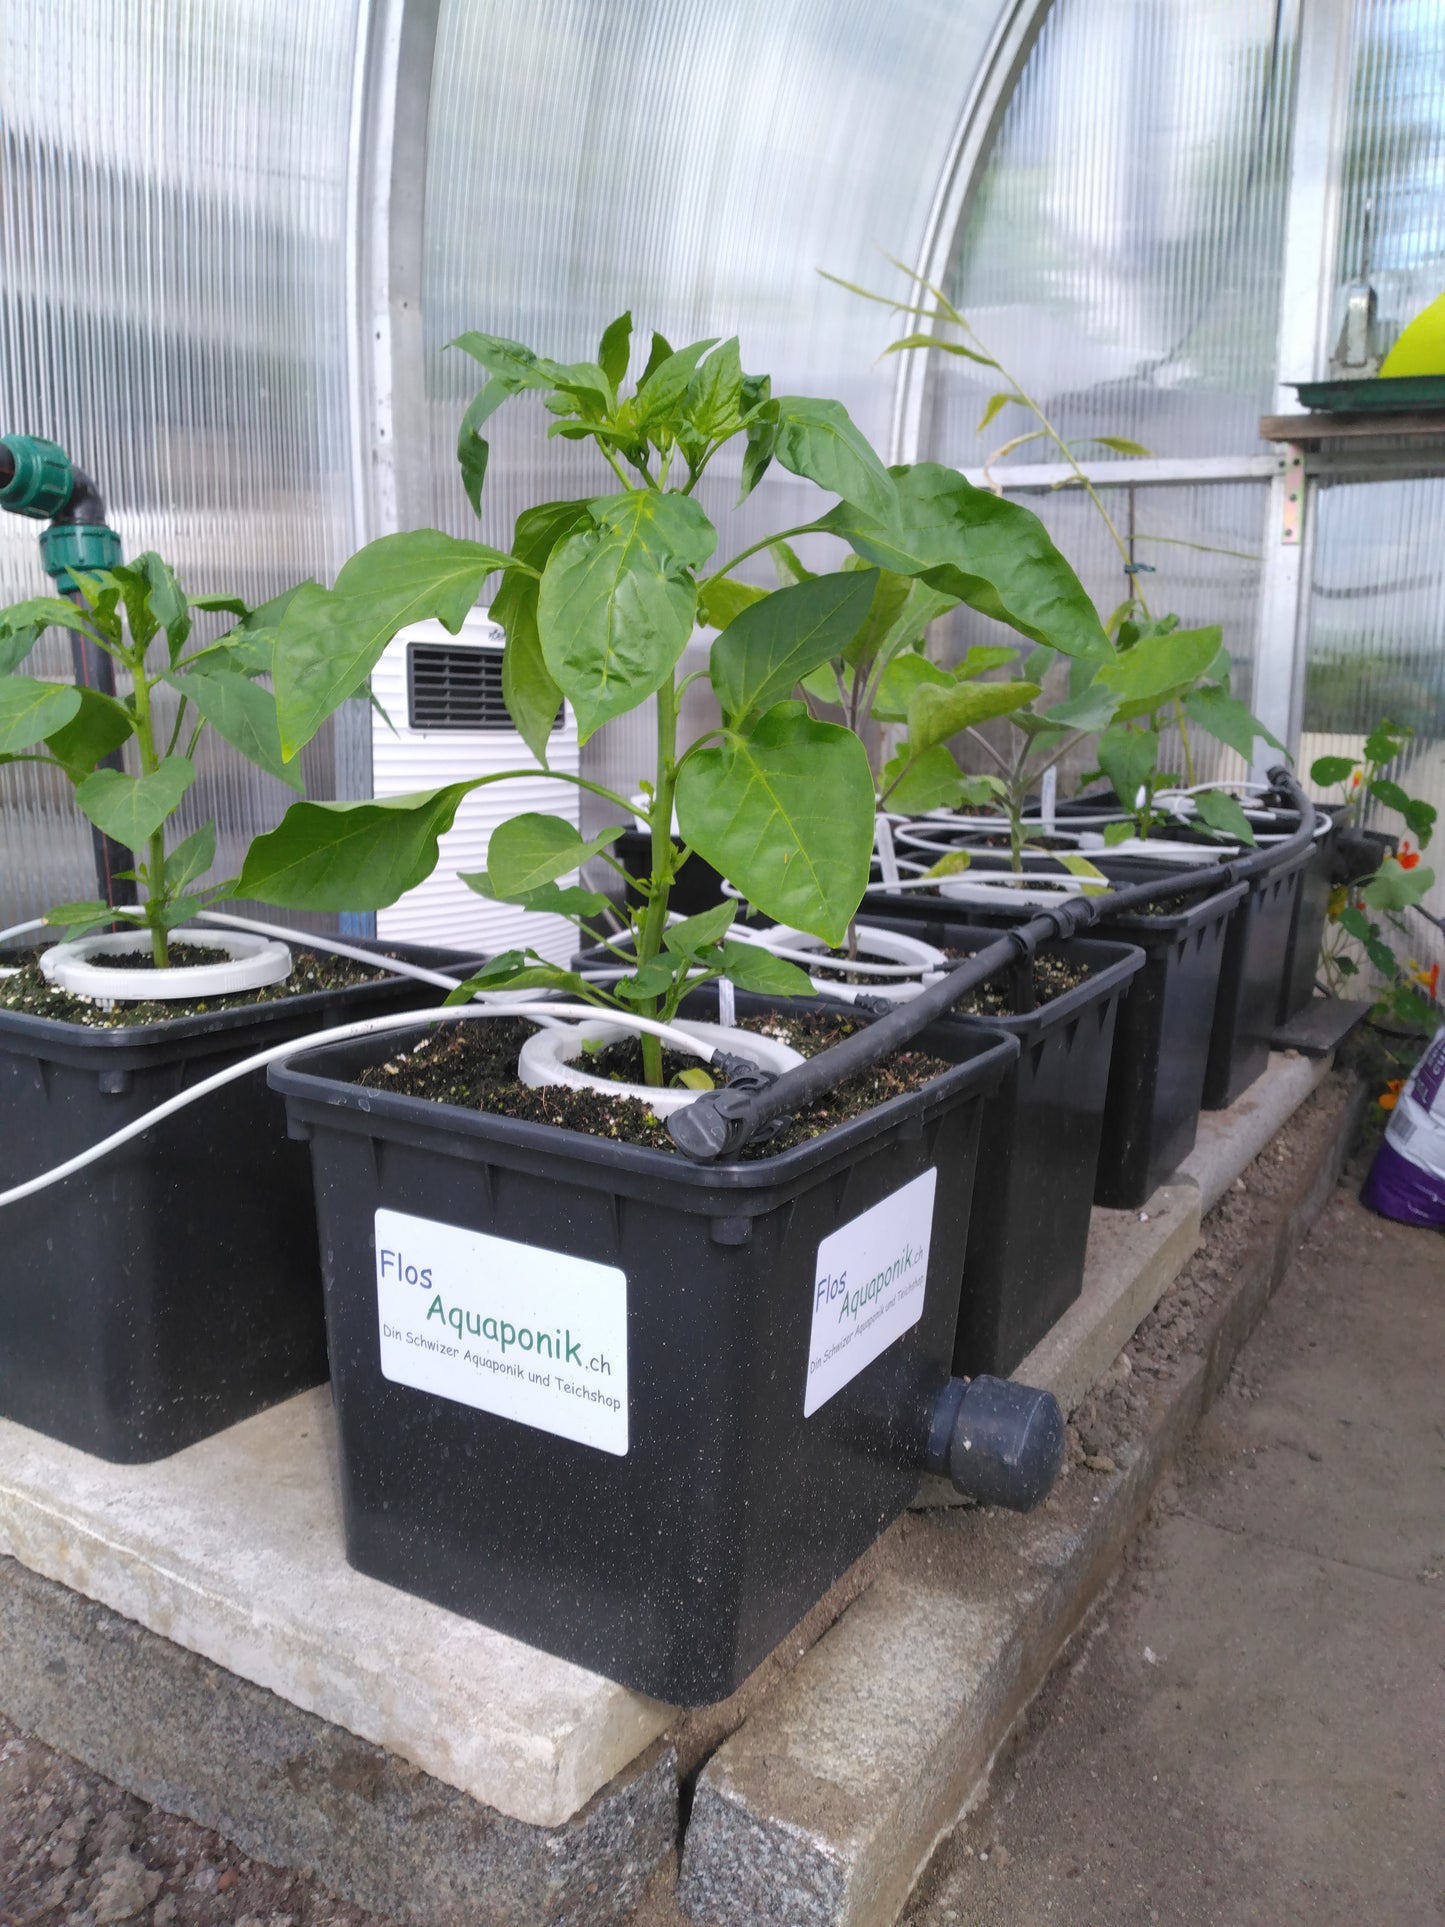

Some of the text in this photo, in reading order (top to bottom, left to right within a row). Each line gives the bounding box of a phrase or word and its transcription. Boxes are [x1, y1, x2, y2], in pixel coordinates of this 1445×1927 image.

[380, 1249, 433, 1289] Flos
[815, 1270, 848, 1313] Flos
[383, 1323, 621, 1412] Din Schwizer Aquaponik und Teichshop
[426, 1294, 612, 1376] Aquaponik.ch
[810, 1357, 822, 1375] Din
[823, 1333, 854, 1364] Schwizer
[854, 1308, 884, 1338] Aquaponik
[885, 1298, 897, 1316] und
